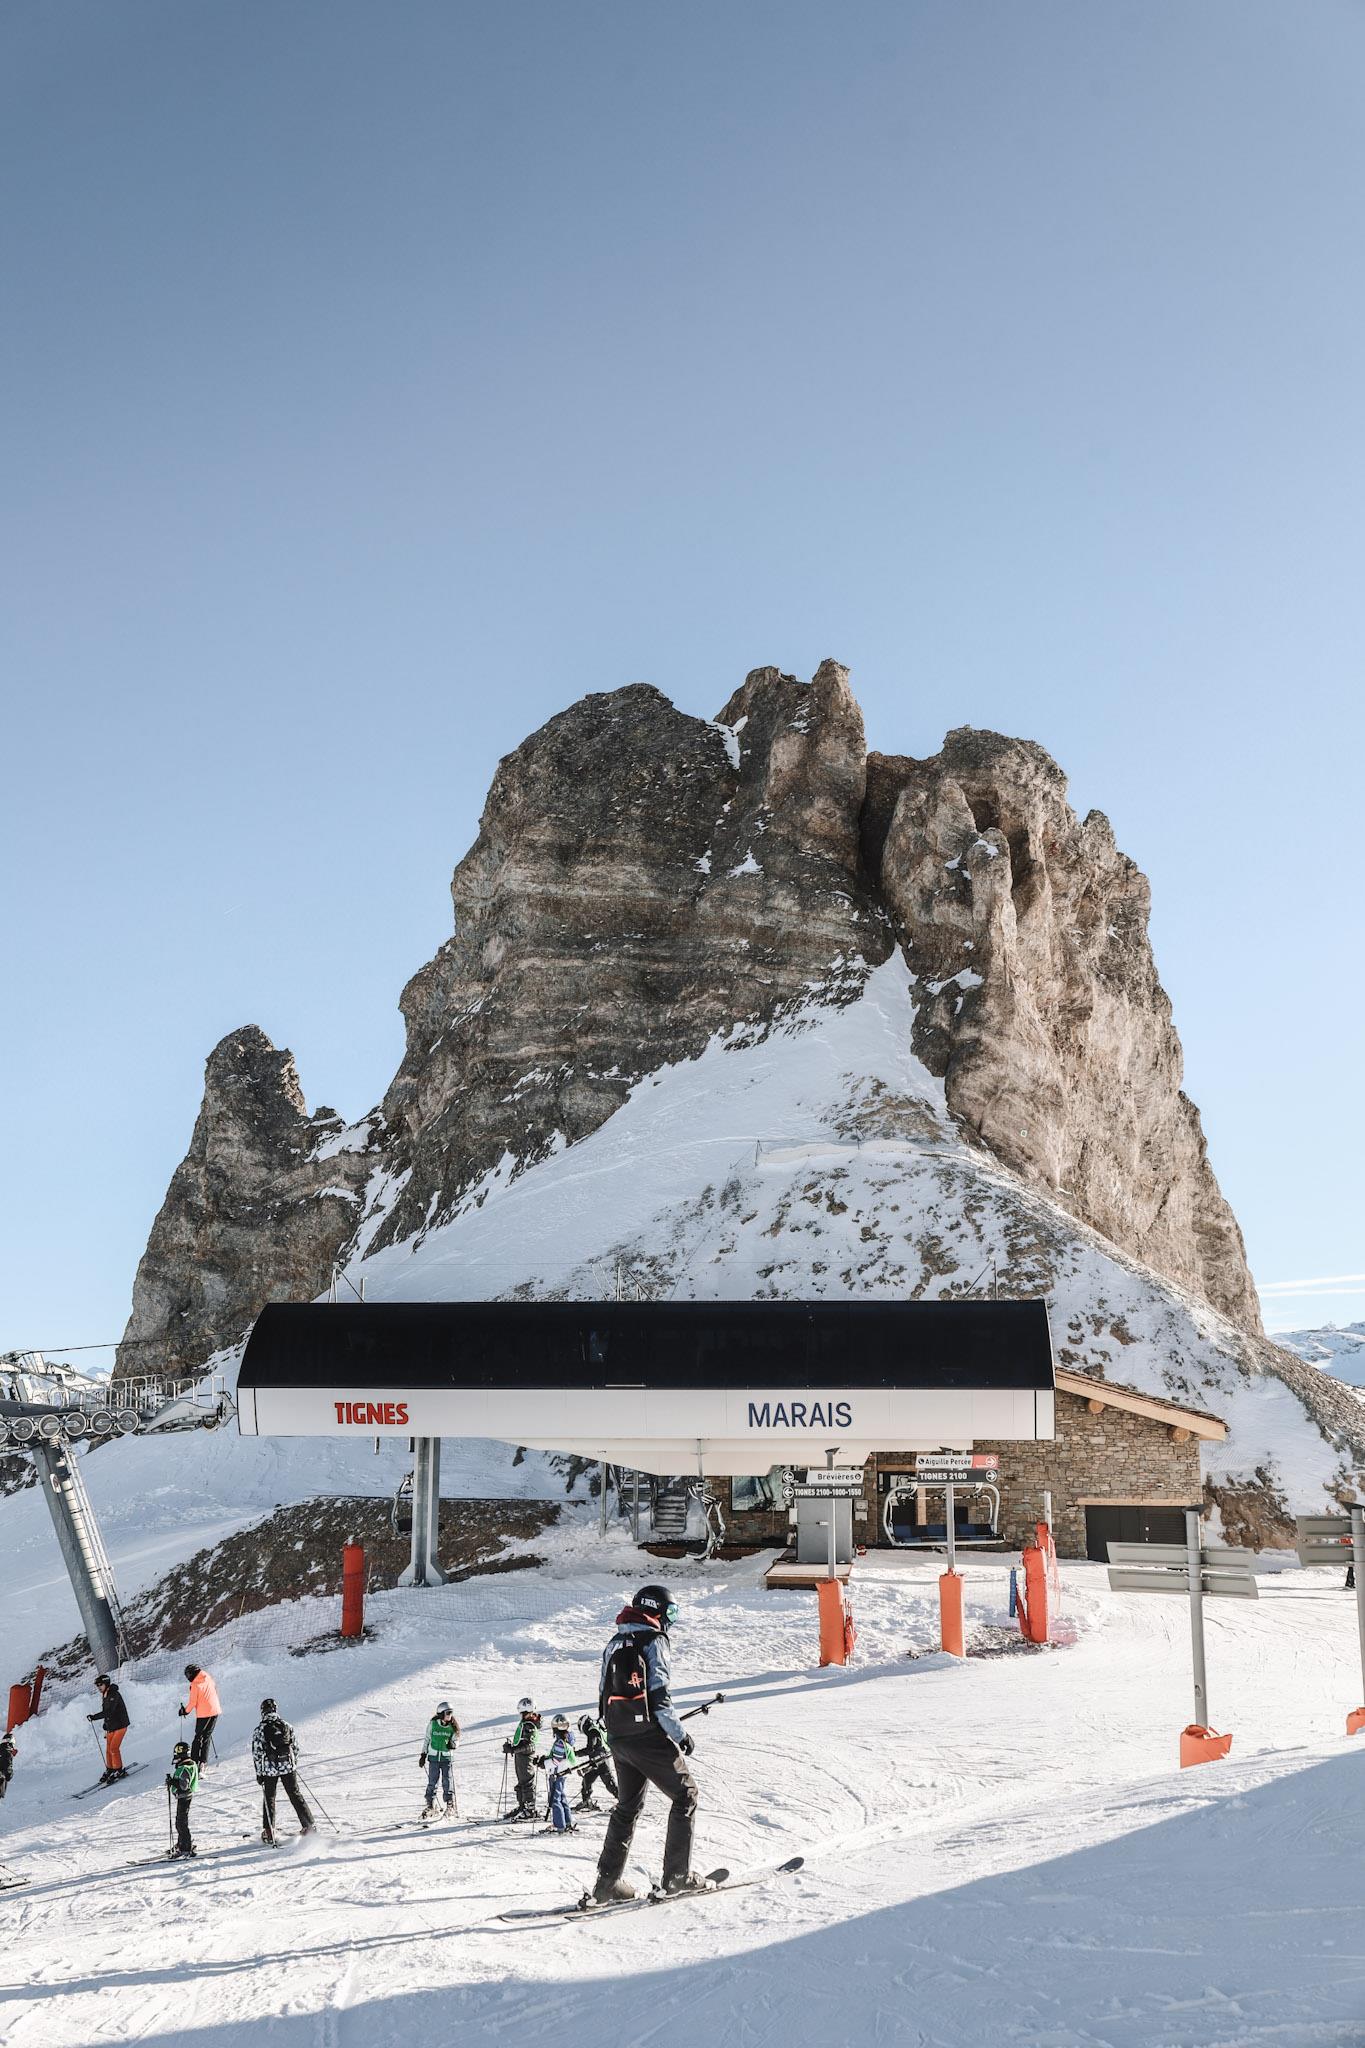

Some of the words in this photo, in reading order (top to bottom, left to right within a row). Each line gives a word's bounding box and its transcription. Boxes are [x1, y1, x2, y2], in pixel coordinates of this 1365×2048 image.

[334, 1402, 409, 1425] TIGNES
[748, 1402, 852, 1428] MARAIS
[925, 1458, 949, 1466] Aiguille
[950, 1457, 971, 1465] Percée
[817, 1472, 854, 1480] Brévières
[920, 1472, 948, 1480] TIGNES
[949, 1472, 967, 1480] 2100
[794, 1488, 815, 1496] TIGNES
